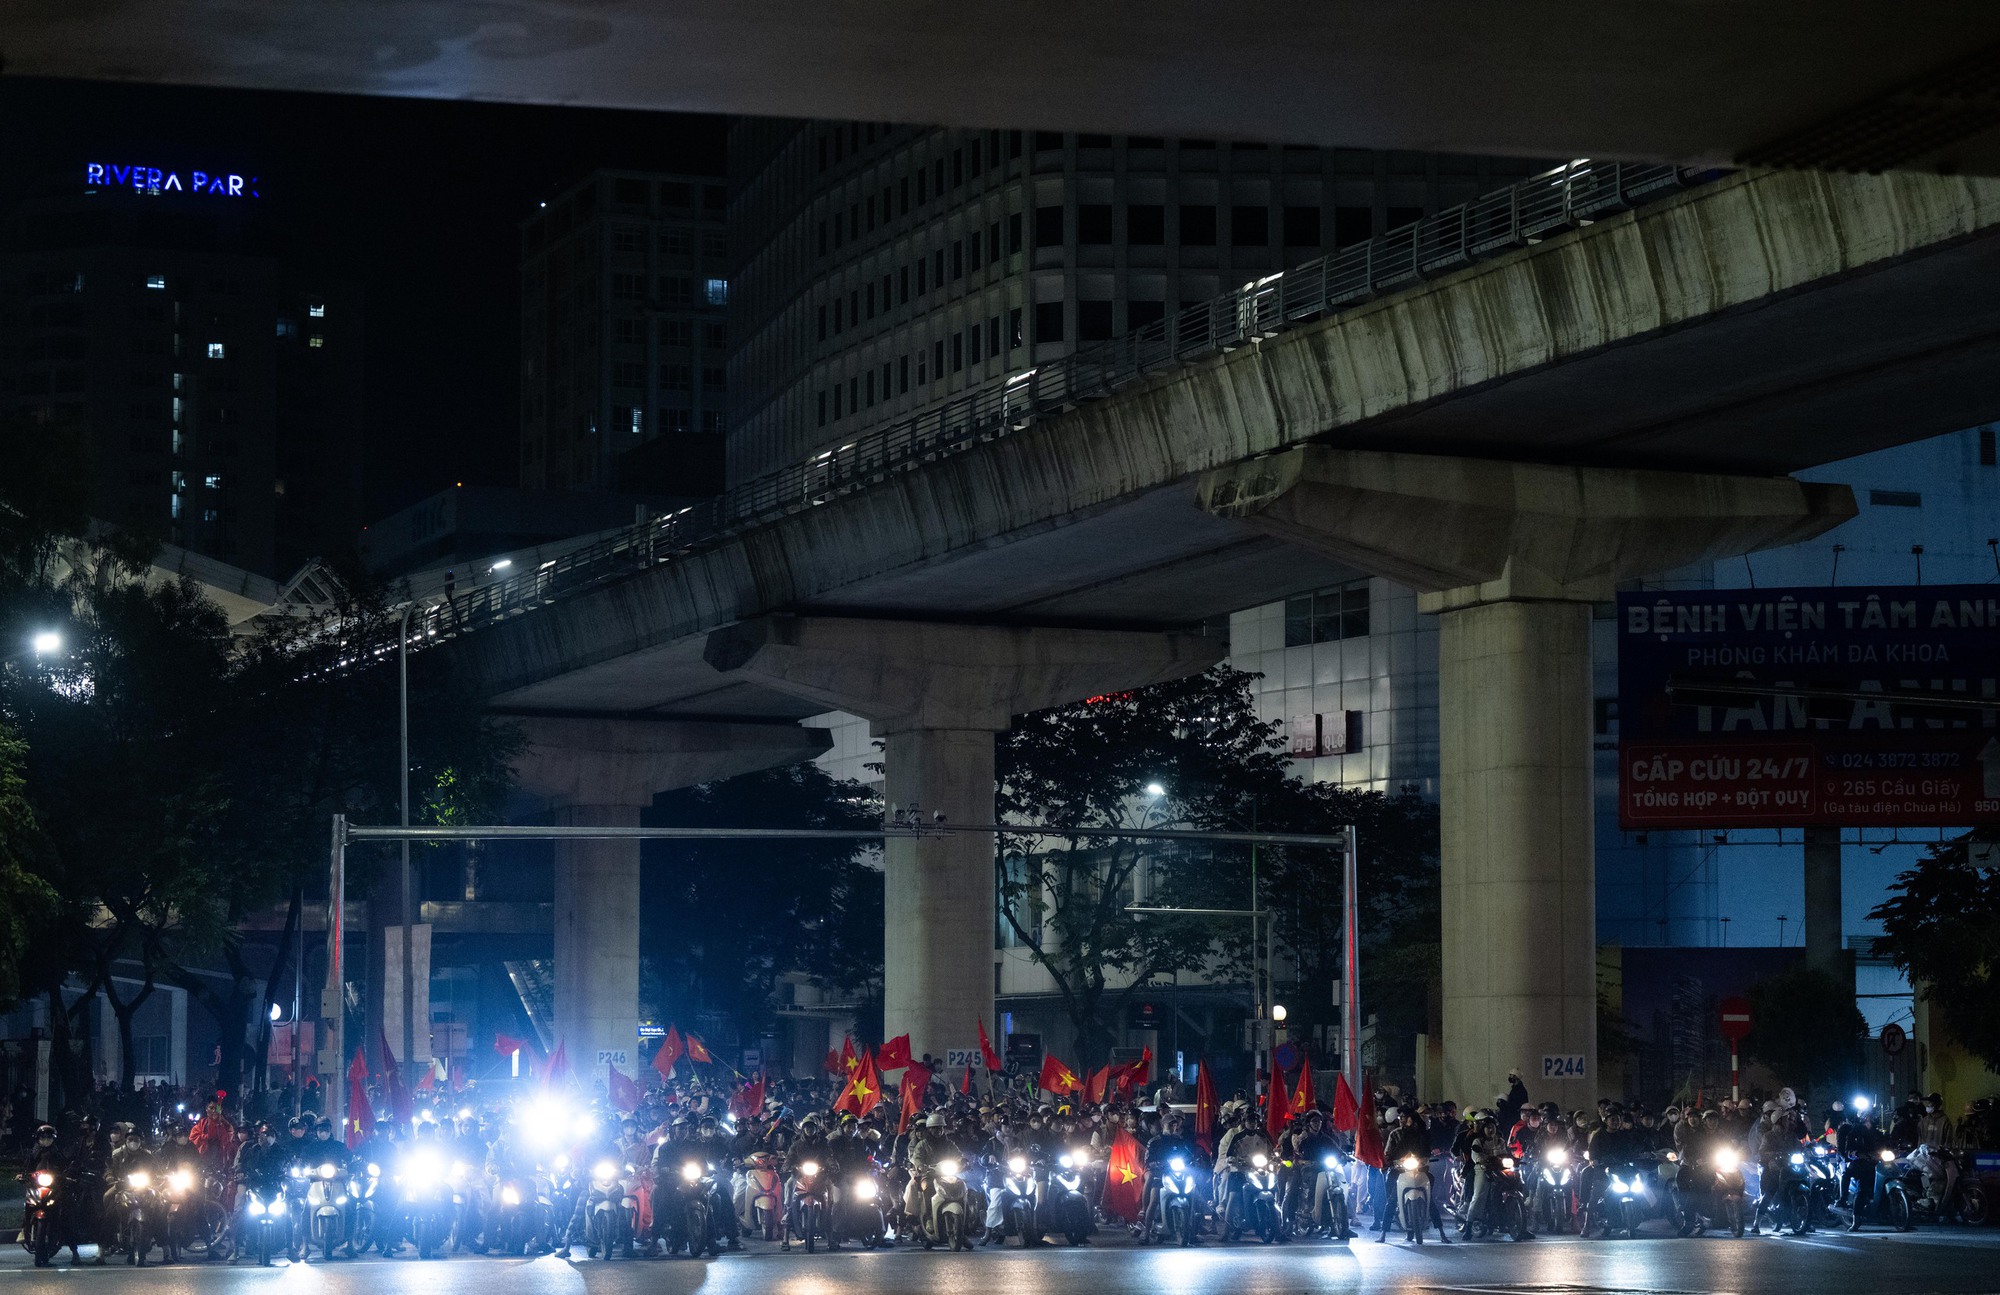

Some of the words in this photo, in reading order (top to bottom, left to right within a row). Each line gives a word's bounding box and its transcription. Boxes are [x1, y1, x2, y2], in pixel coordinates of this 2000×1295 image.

[87, 162, 183, 191] RIVERA
[1627, 599, 1726, 642] BỆNH
[1738, 595, 1825, 639] VIỆN
[1838, 594, 1917, 629] TÂM
[1688, 643, 1766, 666] PHÒNG
[1773, 641, 1839, 664] KHÁM
[1847, 644, 1878, 663] ĐA
[1885, 643, 1950, 662] KHOA
[1632, 753, 1684, 782] CẤP
[1690, 754, 1741, 781] CỨU
[1746, 757, 1810, 780] 24/7
[1842, 753, 1873, 768] 024
[1878, 753, 1918, 768] 3872
[1921, 752, 1960, 767] 3872
[1633, 785, 1678, 807] TỔNG
[1684, 790, 1718, 810] HỢP
[1736, 788, 1770, 809] ĐỘT
[1775, 790, 1810, 808] QUỴ
[1843, 780, 1876, 796] 265
[1881, 778, 1915, 796] Cầu
[1921, 778, 1961, 799] Giấy
[1824, 801, 1845, 814] (Ga
[1849, 801, 1868, 813] tàu
[1873, 801, 1900, 815] điện
[1904, 801, 1936, 813] Chùa
[1939, 801, 1961, 814] Hà)
[1974, 801, 2000, 812] 950
[599, 1051, 626, 1063] P246
[949, 1051, 981, 1065] P245
[1544, 1057, 1584, 1076] P244
